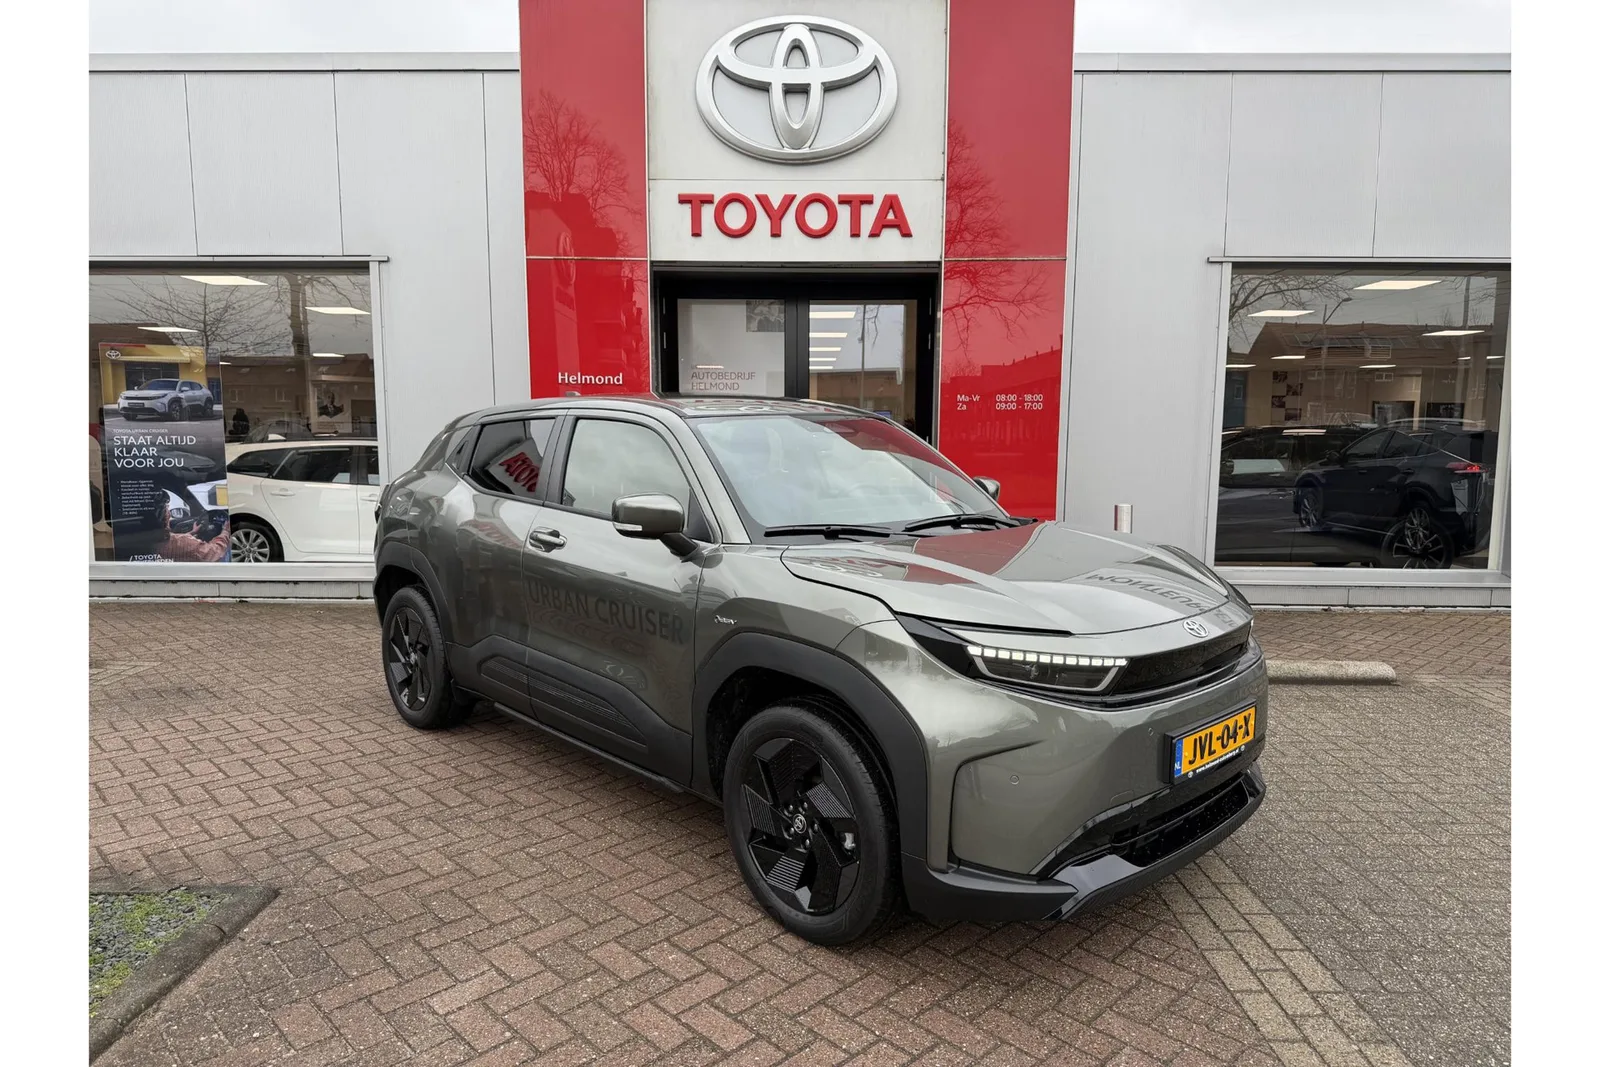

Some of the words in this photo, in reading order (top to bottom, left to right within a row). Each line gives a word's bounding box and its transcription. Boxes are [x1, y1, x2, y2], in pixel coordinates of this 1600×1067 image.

[678, 193, 913, 238] TOYOTA
[558, 372, 623, 385] Helmond
[691, 371, 756, 381] AUTOBEDRIJF
[691, 382, 740, 391] HELMOND
[957, 394, 981, 402] Ma-Vr
[995, 393, 1017, 402] 08:00
[1024, 393, 1044, 402] 18:00
[957, 402, 967, 410] Za
[995, 402, 1017, 410] 09:00
[1024, 402, 1043, 410] 17:00
[113, 435, 153, 446] STAAT
[156, 435, 197, 445] ALTIJD
[114, 447, 158, 457] KLAAR
[114, 458, 155, 468] VOOR
[158, 458, 184, 468] JOU
[527, 578, 589, 619] URBAN
[595, 598, 684, 645] CRUISER
[1188, 713, 1251, 765] JVL-04-X
[1174, 761, 1181, 770] NL
